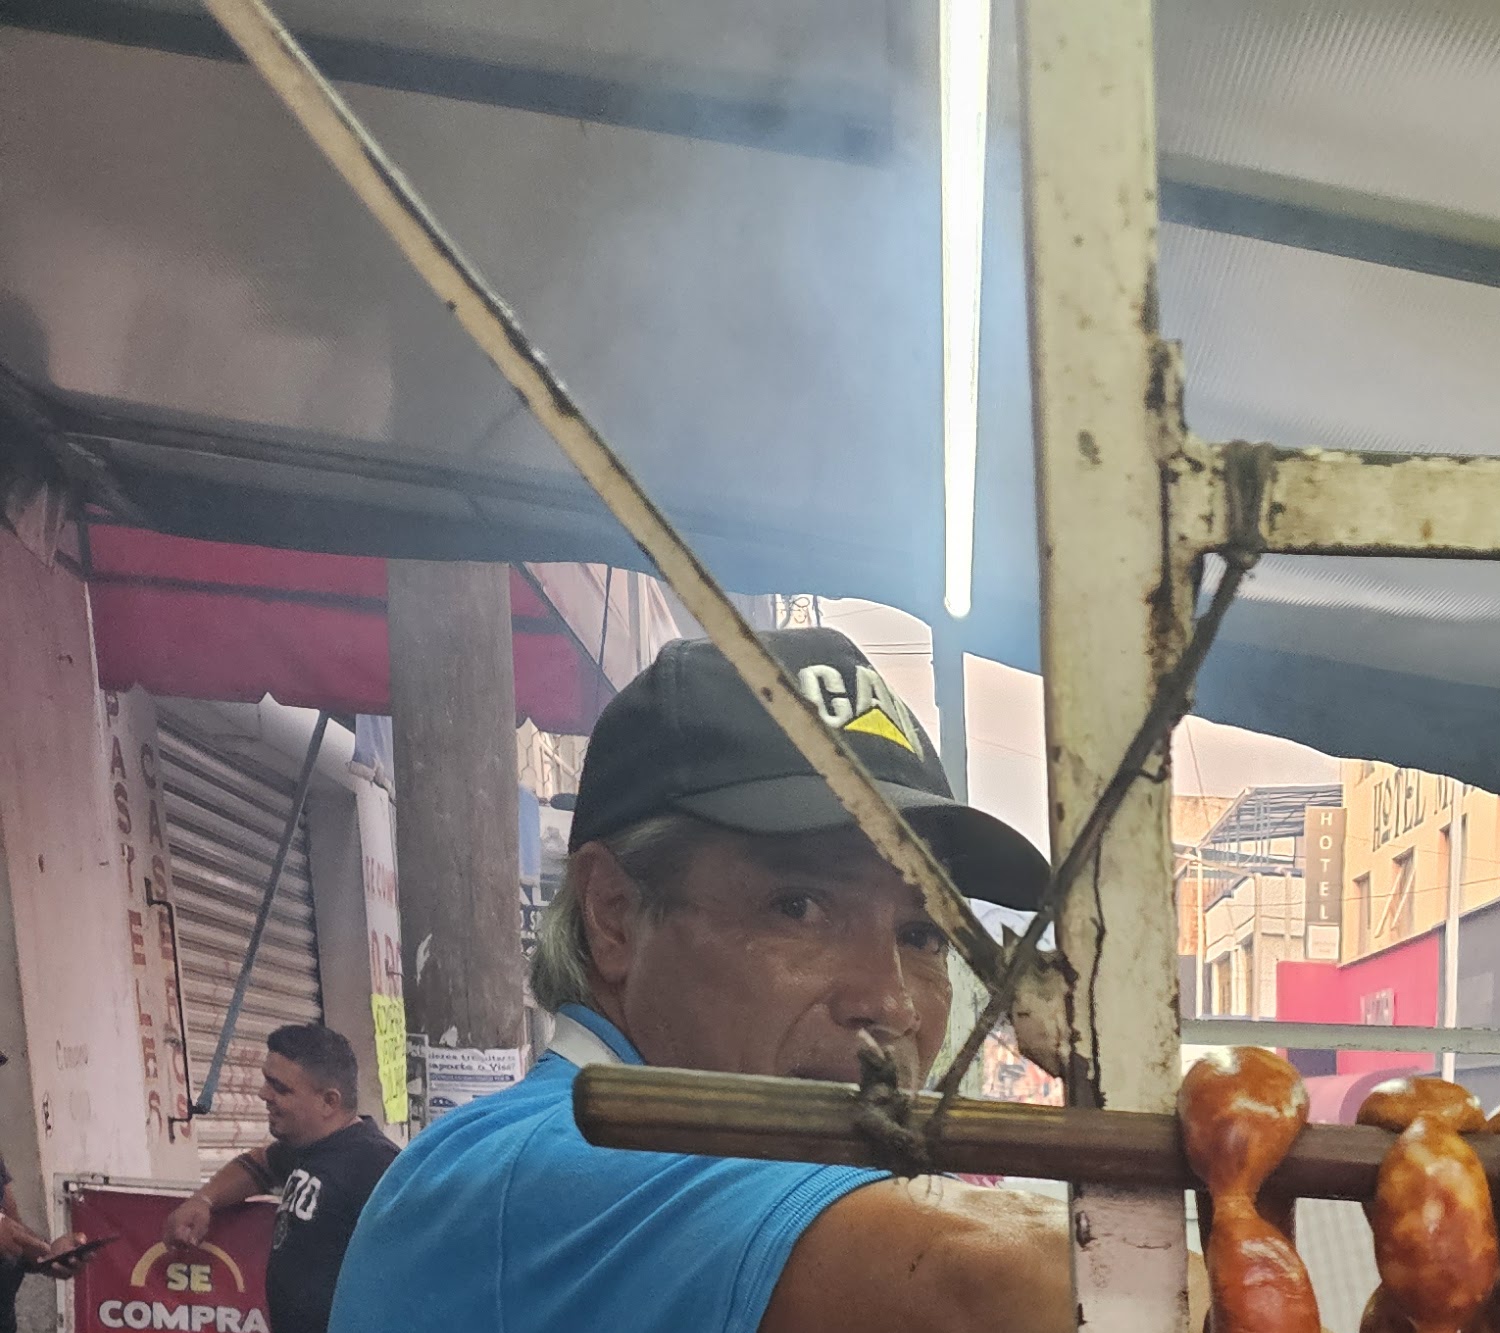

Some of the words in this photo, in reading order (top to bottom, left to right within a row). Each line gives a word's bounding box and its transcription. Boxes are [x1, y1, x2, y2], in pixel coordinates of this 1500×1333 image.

[1373, 770, 1427, 853] HOTEL
[1319, 812, 1333, 920] HOTEL
[166, 1262, 213, 1293] SE
